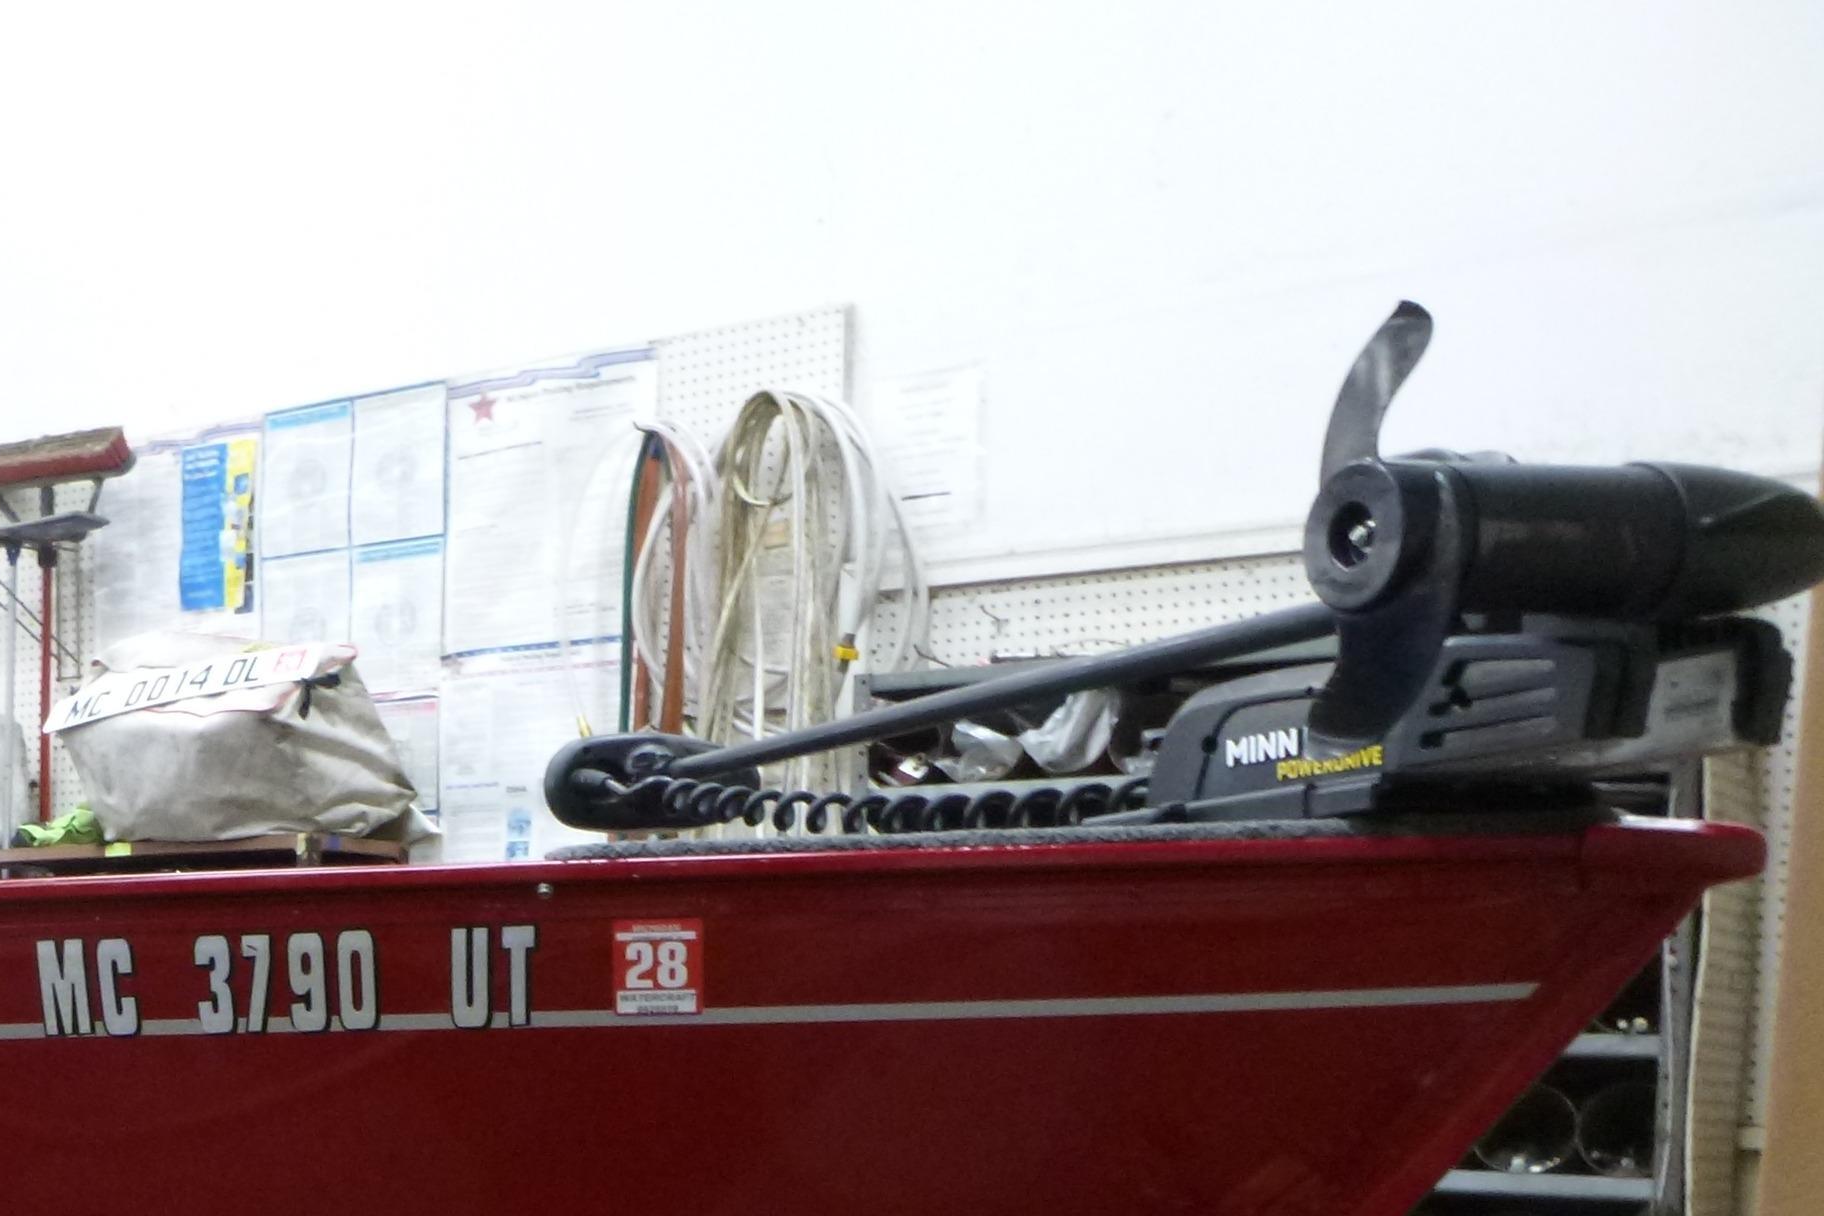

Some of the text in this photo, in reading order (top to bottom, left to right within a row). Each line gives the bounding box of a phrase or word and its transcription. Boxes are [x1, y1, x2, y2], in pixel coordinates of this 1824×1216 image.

[65, 690, 112, 725] MC
[1225, 727, 1299, 768] MINN
[36, 925, 537, 1037] MC 3790 UT
[625, 941, 688, 990] 28
